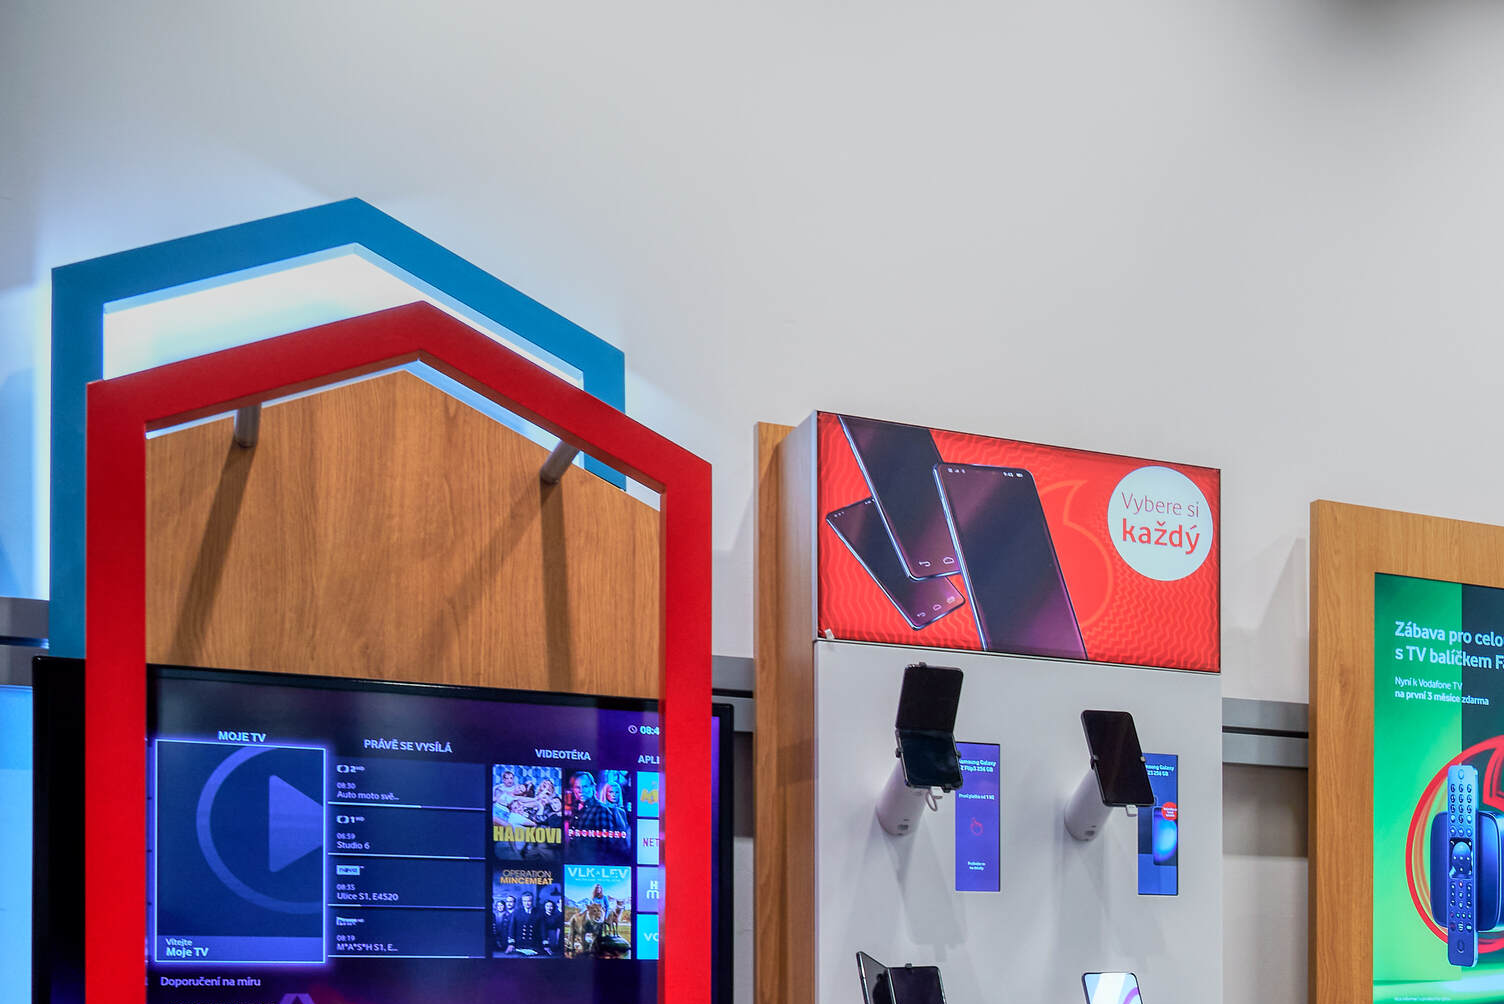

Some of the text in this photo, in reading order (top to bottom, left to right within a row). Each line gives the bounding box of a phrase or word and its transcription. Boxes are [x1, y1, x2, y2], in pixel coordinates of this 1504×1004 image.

[1122, 492, 1200, 518] Vybere si
[1122, 518, 1200, 554] každý
[1394, 620, 1446, 640] Zábava
[1449, 630, 1472, 645] pro
[1395, 648, 1403, 660] s
[1406, 645, 1426, 662] TV
[1430, 648, 1492, 669] balíčkem
[1395, 676, 1412, 688] Nyní
[1419, 678, 1451, 689] Vodafone
[1453, 682, 1463, 690] TV
[1406, 690, 1426, 700] první
[1427, 692, 1432, 700] 3
[1434, 693, 1460, 702] měsíce
[1462, 695, 1489, 705] zdarma
[218, 731, 266, 742] MOJE TV
[363, 738, 453, 753] PRÁVĚ SE VYSÍLÁ
[535, 748, 591, 761] VIDEOTÉKA
[336, 791, 356, 799] Auto
[336, 841, 363, 849] Studio
[502, 869, 552, 878] OPERATION
[568, 867, 628, 879] VLK LEV
[500, 876, 553, 885] MINCEMEAT
[166, 947, 209, 958] Moje TV
[160, 976, 220, 988] Doporučení
[237, 976, 261, 986] míru
